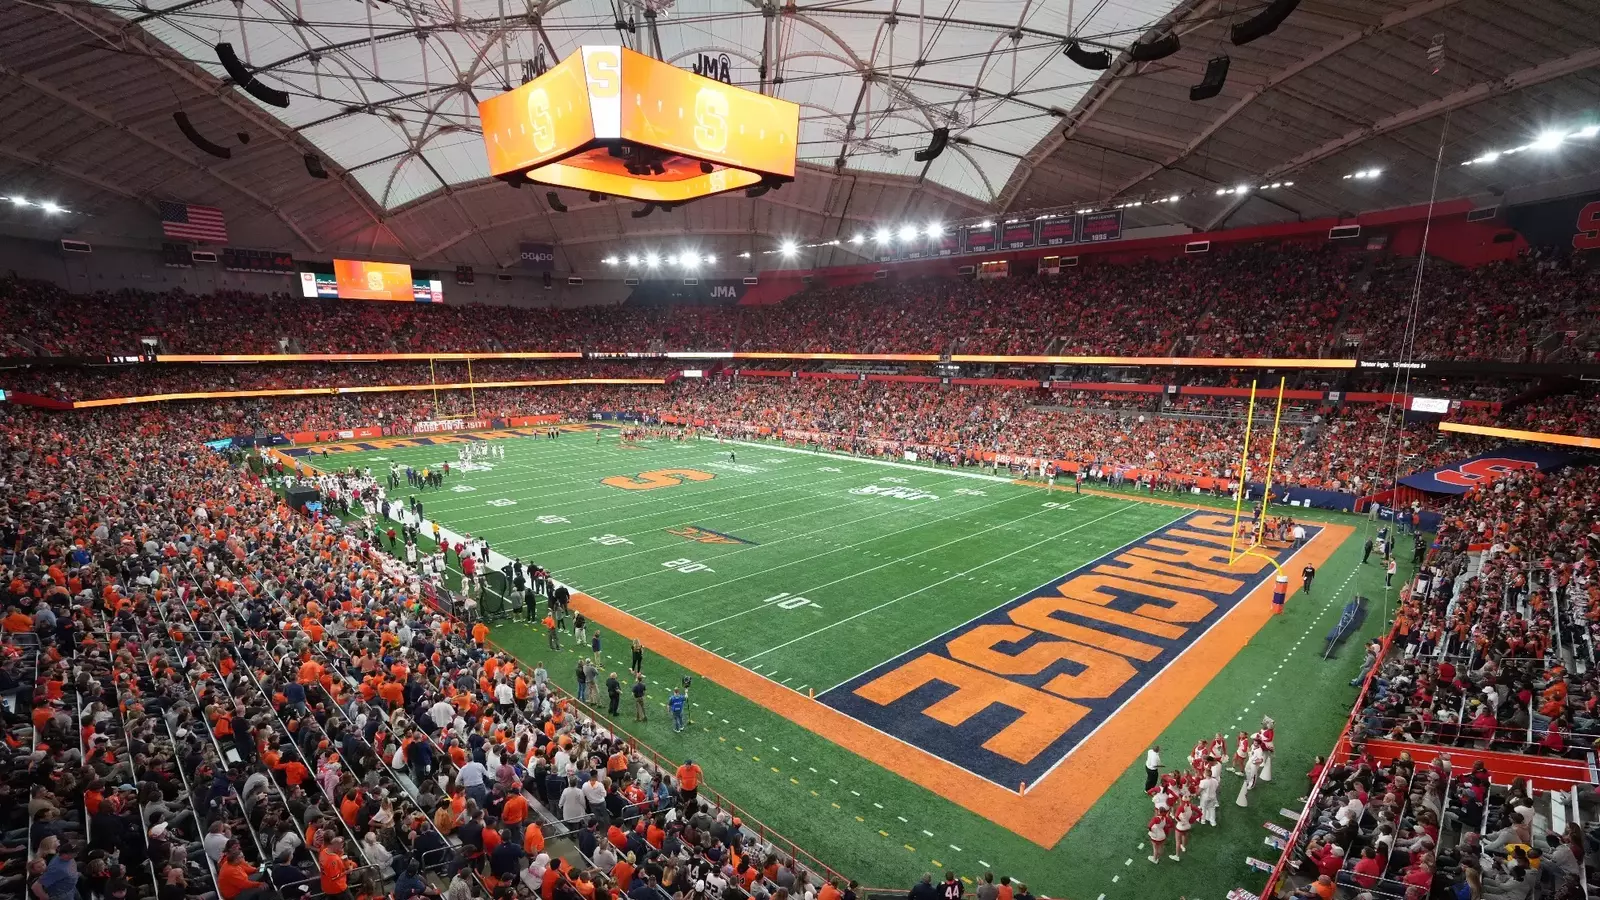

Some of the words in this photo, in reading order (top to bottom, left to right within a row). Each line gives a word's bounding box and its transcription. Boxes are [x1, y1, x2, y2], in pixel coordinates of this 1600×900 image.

[584, 51, 620, 98] S
[692, 53, 732, 86] JMA
[694, 87, 729, 153] S
[710, 286, 737, 298] JMA
[600, 468, 716, 490] S
[661, 558, 707, 573] 20
[763, 592, 812, 610] 10
[851, 514, 1293, 765] SYRACUSE
[945, 885, 960, 900] 44
